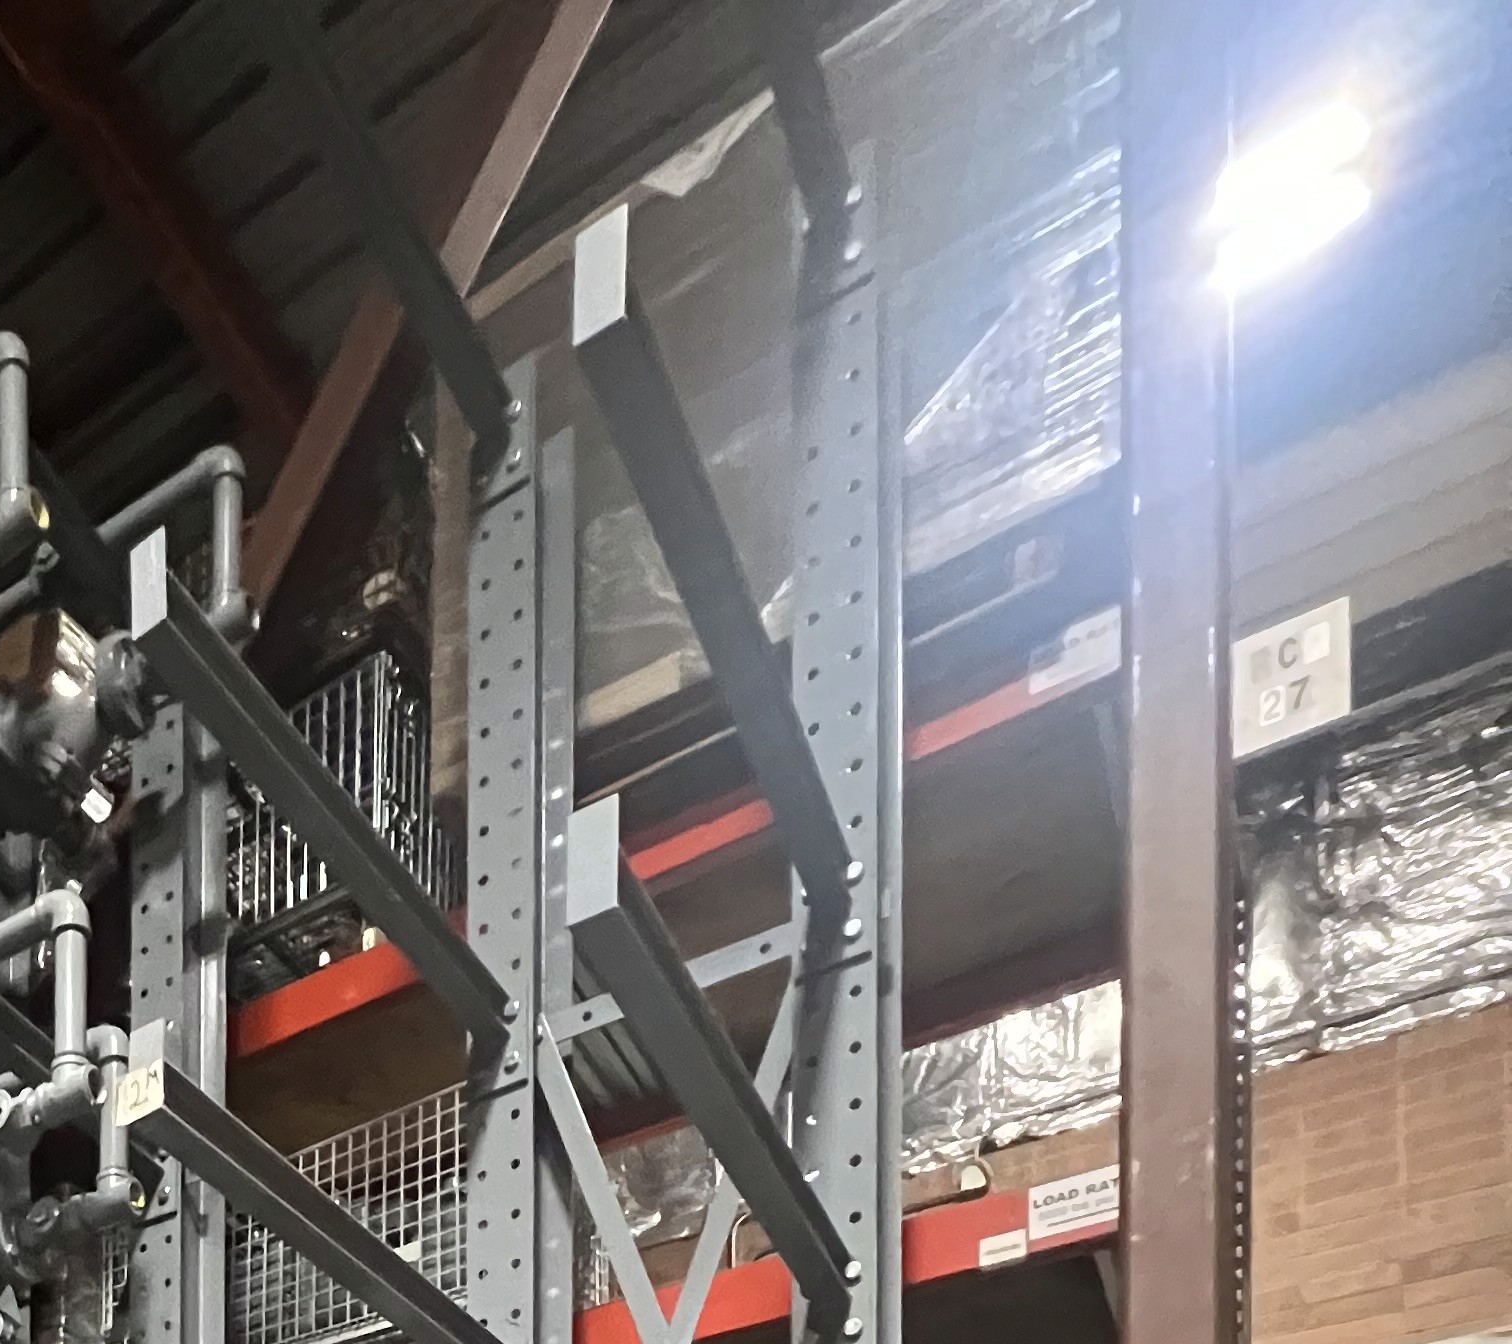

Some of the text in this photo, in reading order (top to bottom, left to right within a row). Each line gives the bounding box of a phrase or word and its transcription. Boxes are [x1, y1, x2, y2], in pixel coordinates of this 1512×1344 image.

[1277, 637, 1298, 669] C
[1263, 674, 1312, 721] 27
[1033, 1188, 1080, 1209] LOAD
